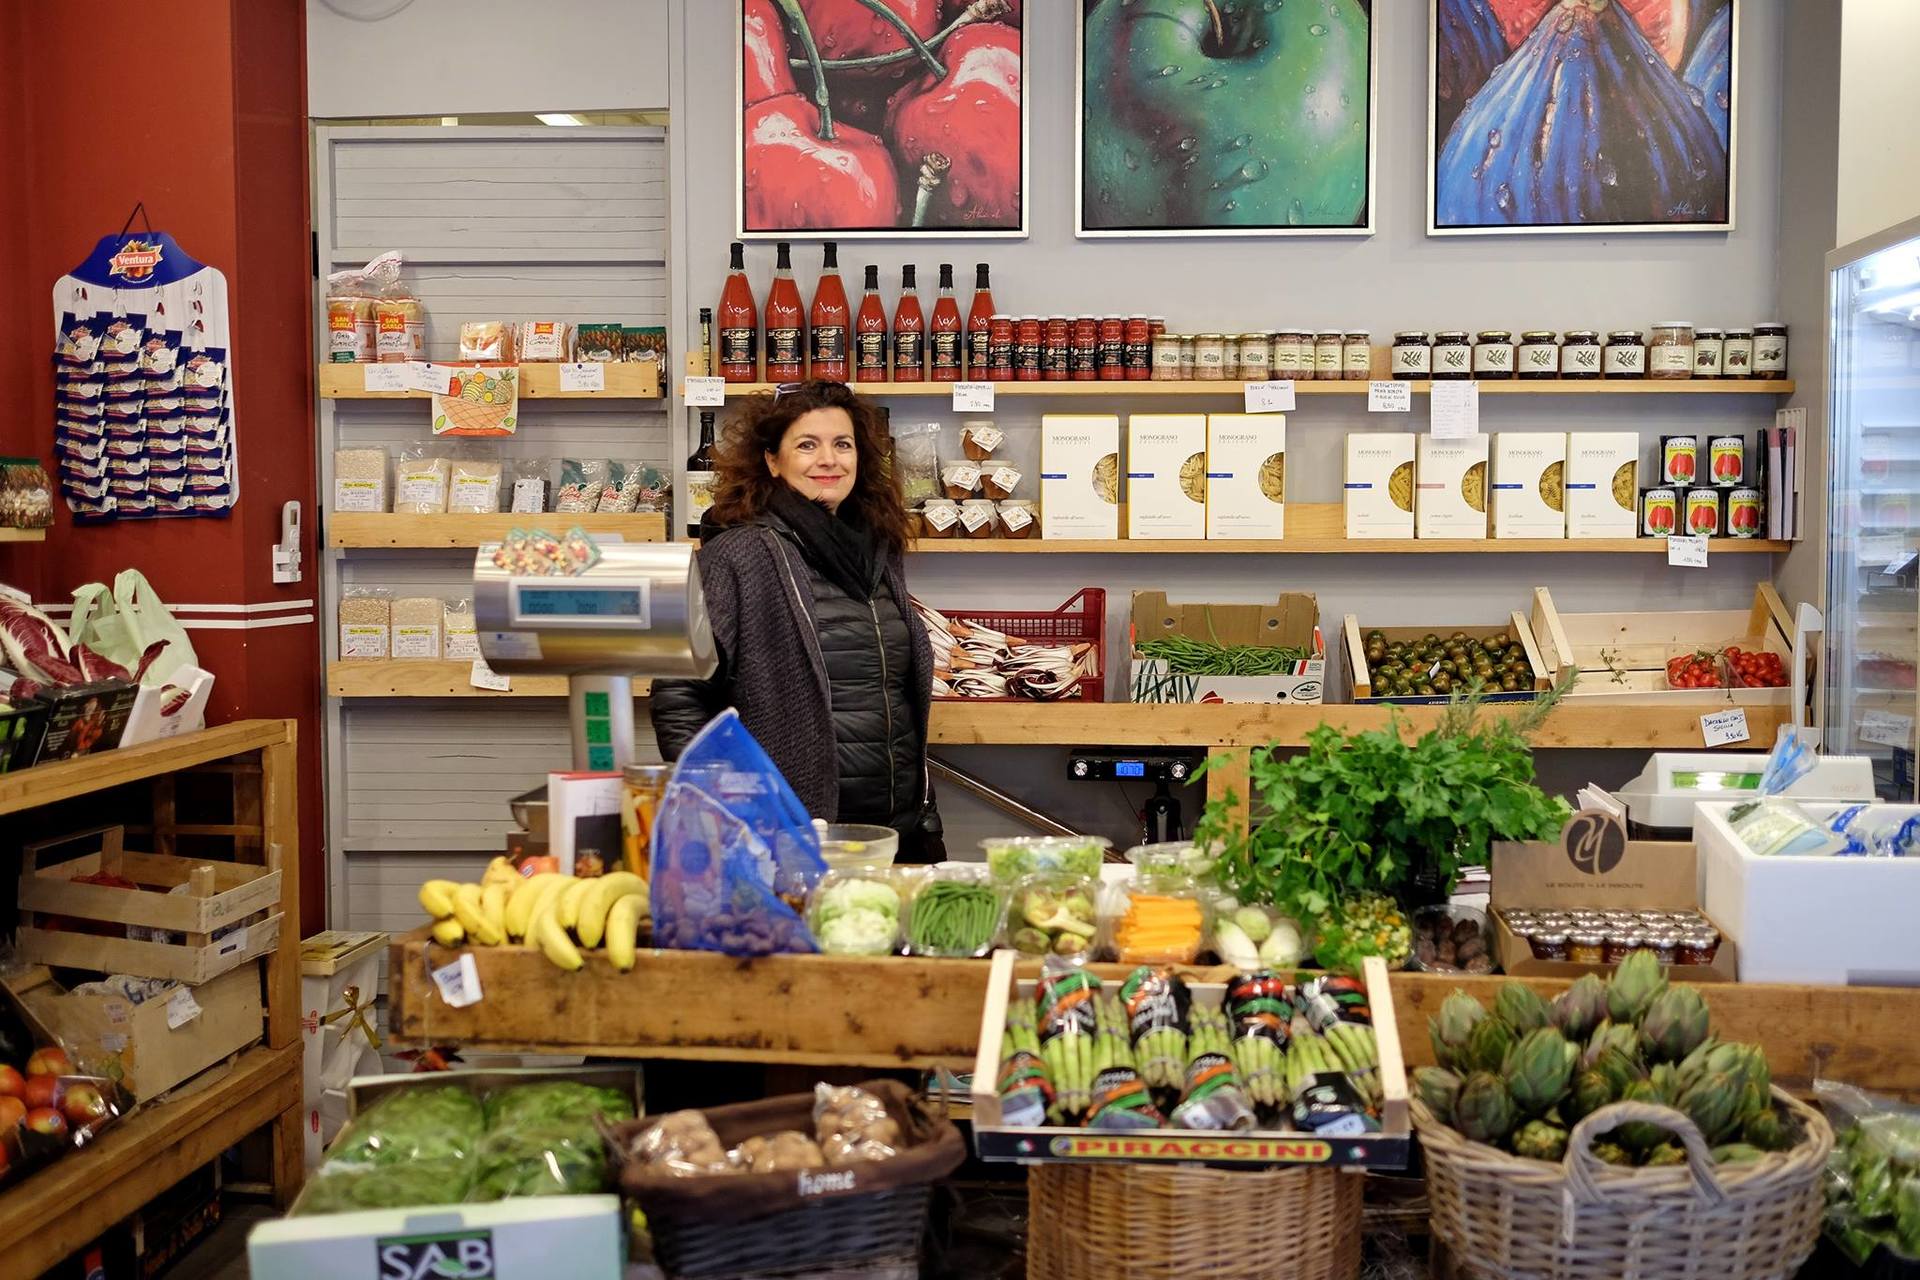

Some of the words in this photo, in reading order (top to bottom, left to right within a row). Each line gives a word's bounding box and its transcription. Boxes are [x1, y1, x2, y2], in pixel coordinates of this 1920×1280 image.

[118, 255, 154, 266] Ventura
[1076, 1140, 1324, 1159] PIRACCINI
[799, 1168, 856, 1196] home
[382, 1239, 493, 1280] SAB
